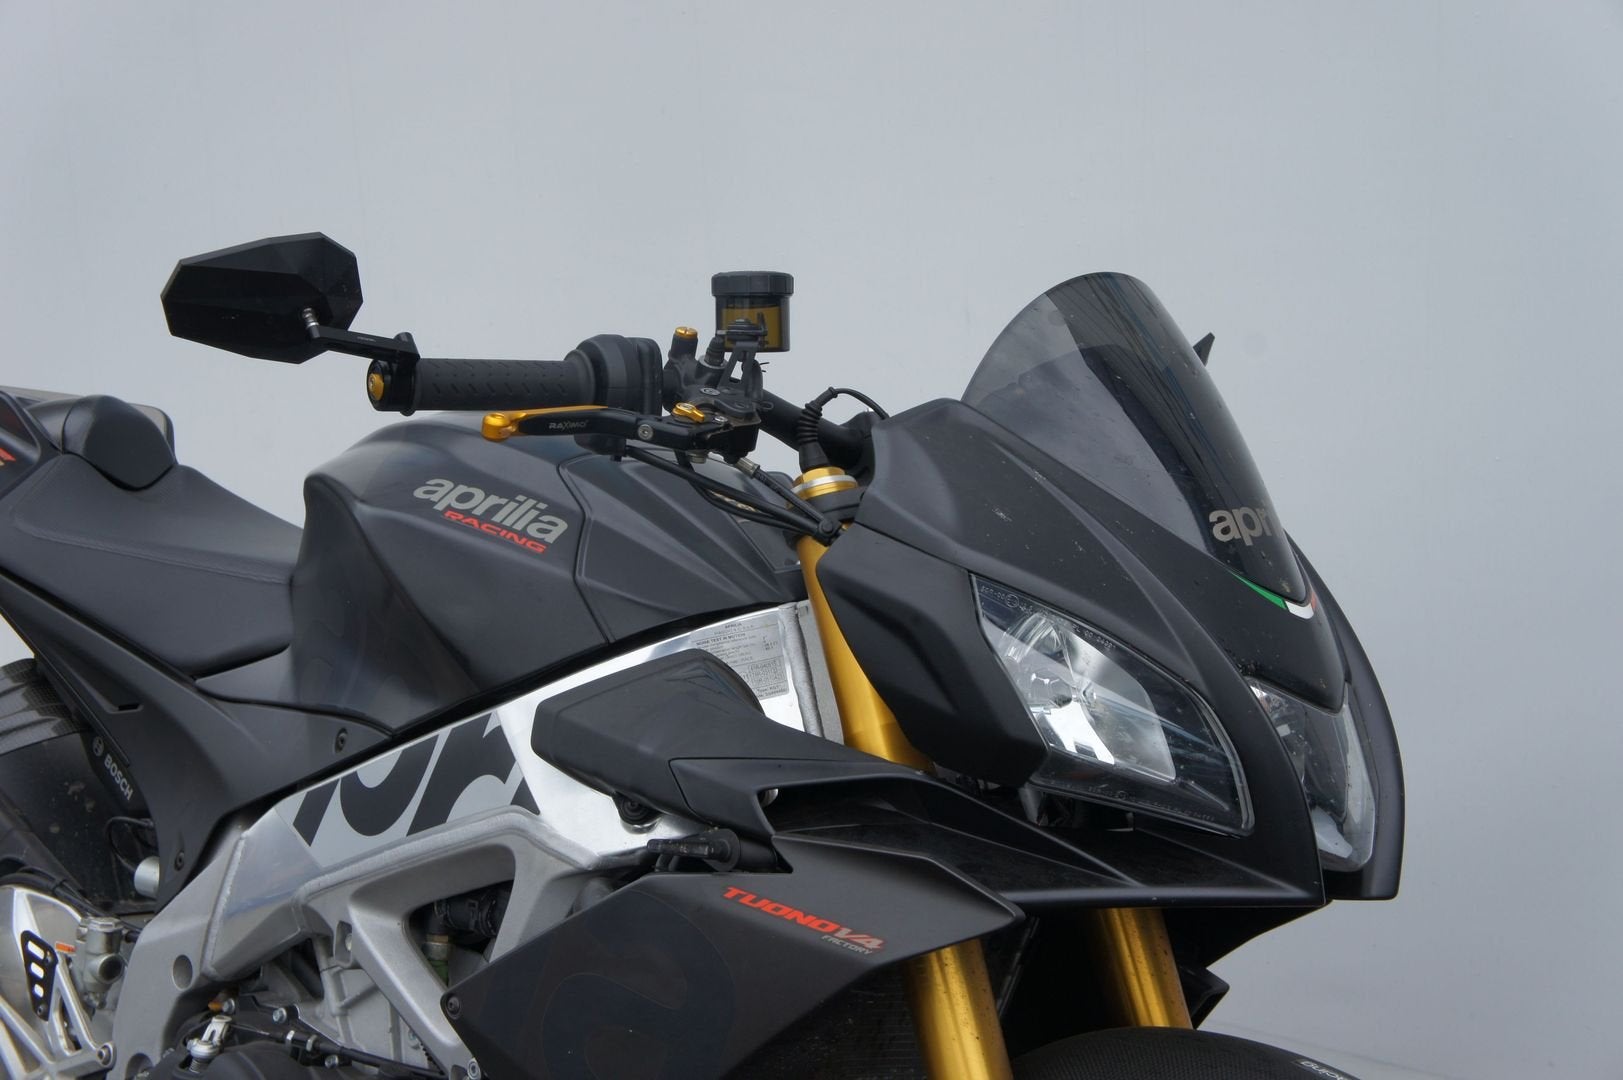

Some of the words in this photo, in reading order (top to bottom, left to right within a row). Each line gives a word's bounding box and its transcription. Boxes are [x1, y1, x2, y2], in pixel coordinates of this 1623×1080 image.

[413, 478, 568, 544] aprilia
[443, 510, 547, 554] RACING
[104, 753, 133, 801] BOSCH
[821, 934, 873, 955] FACTORY
